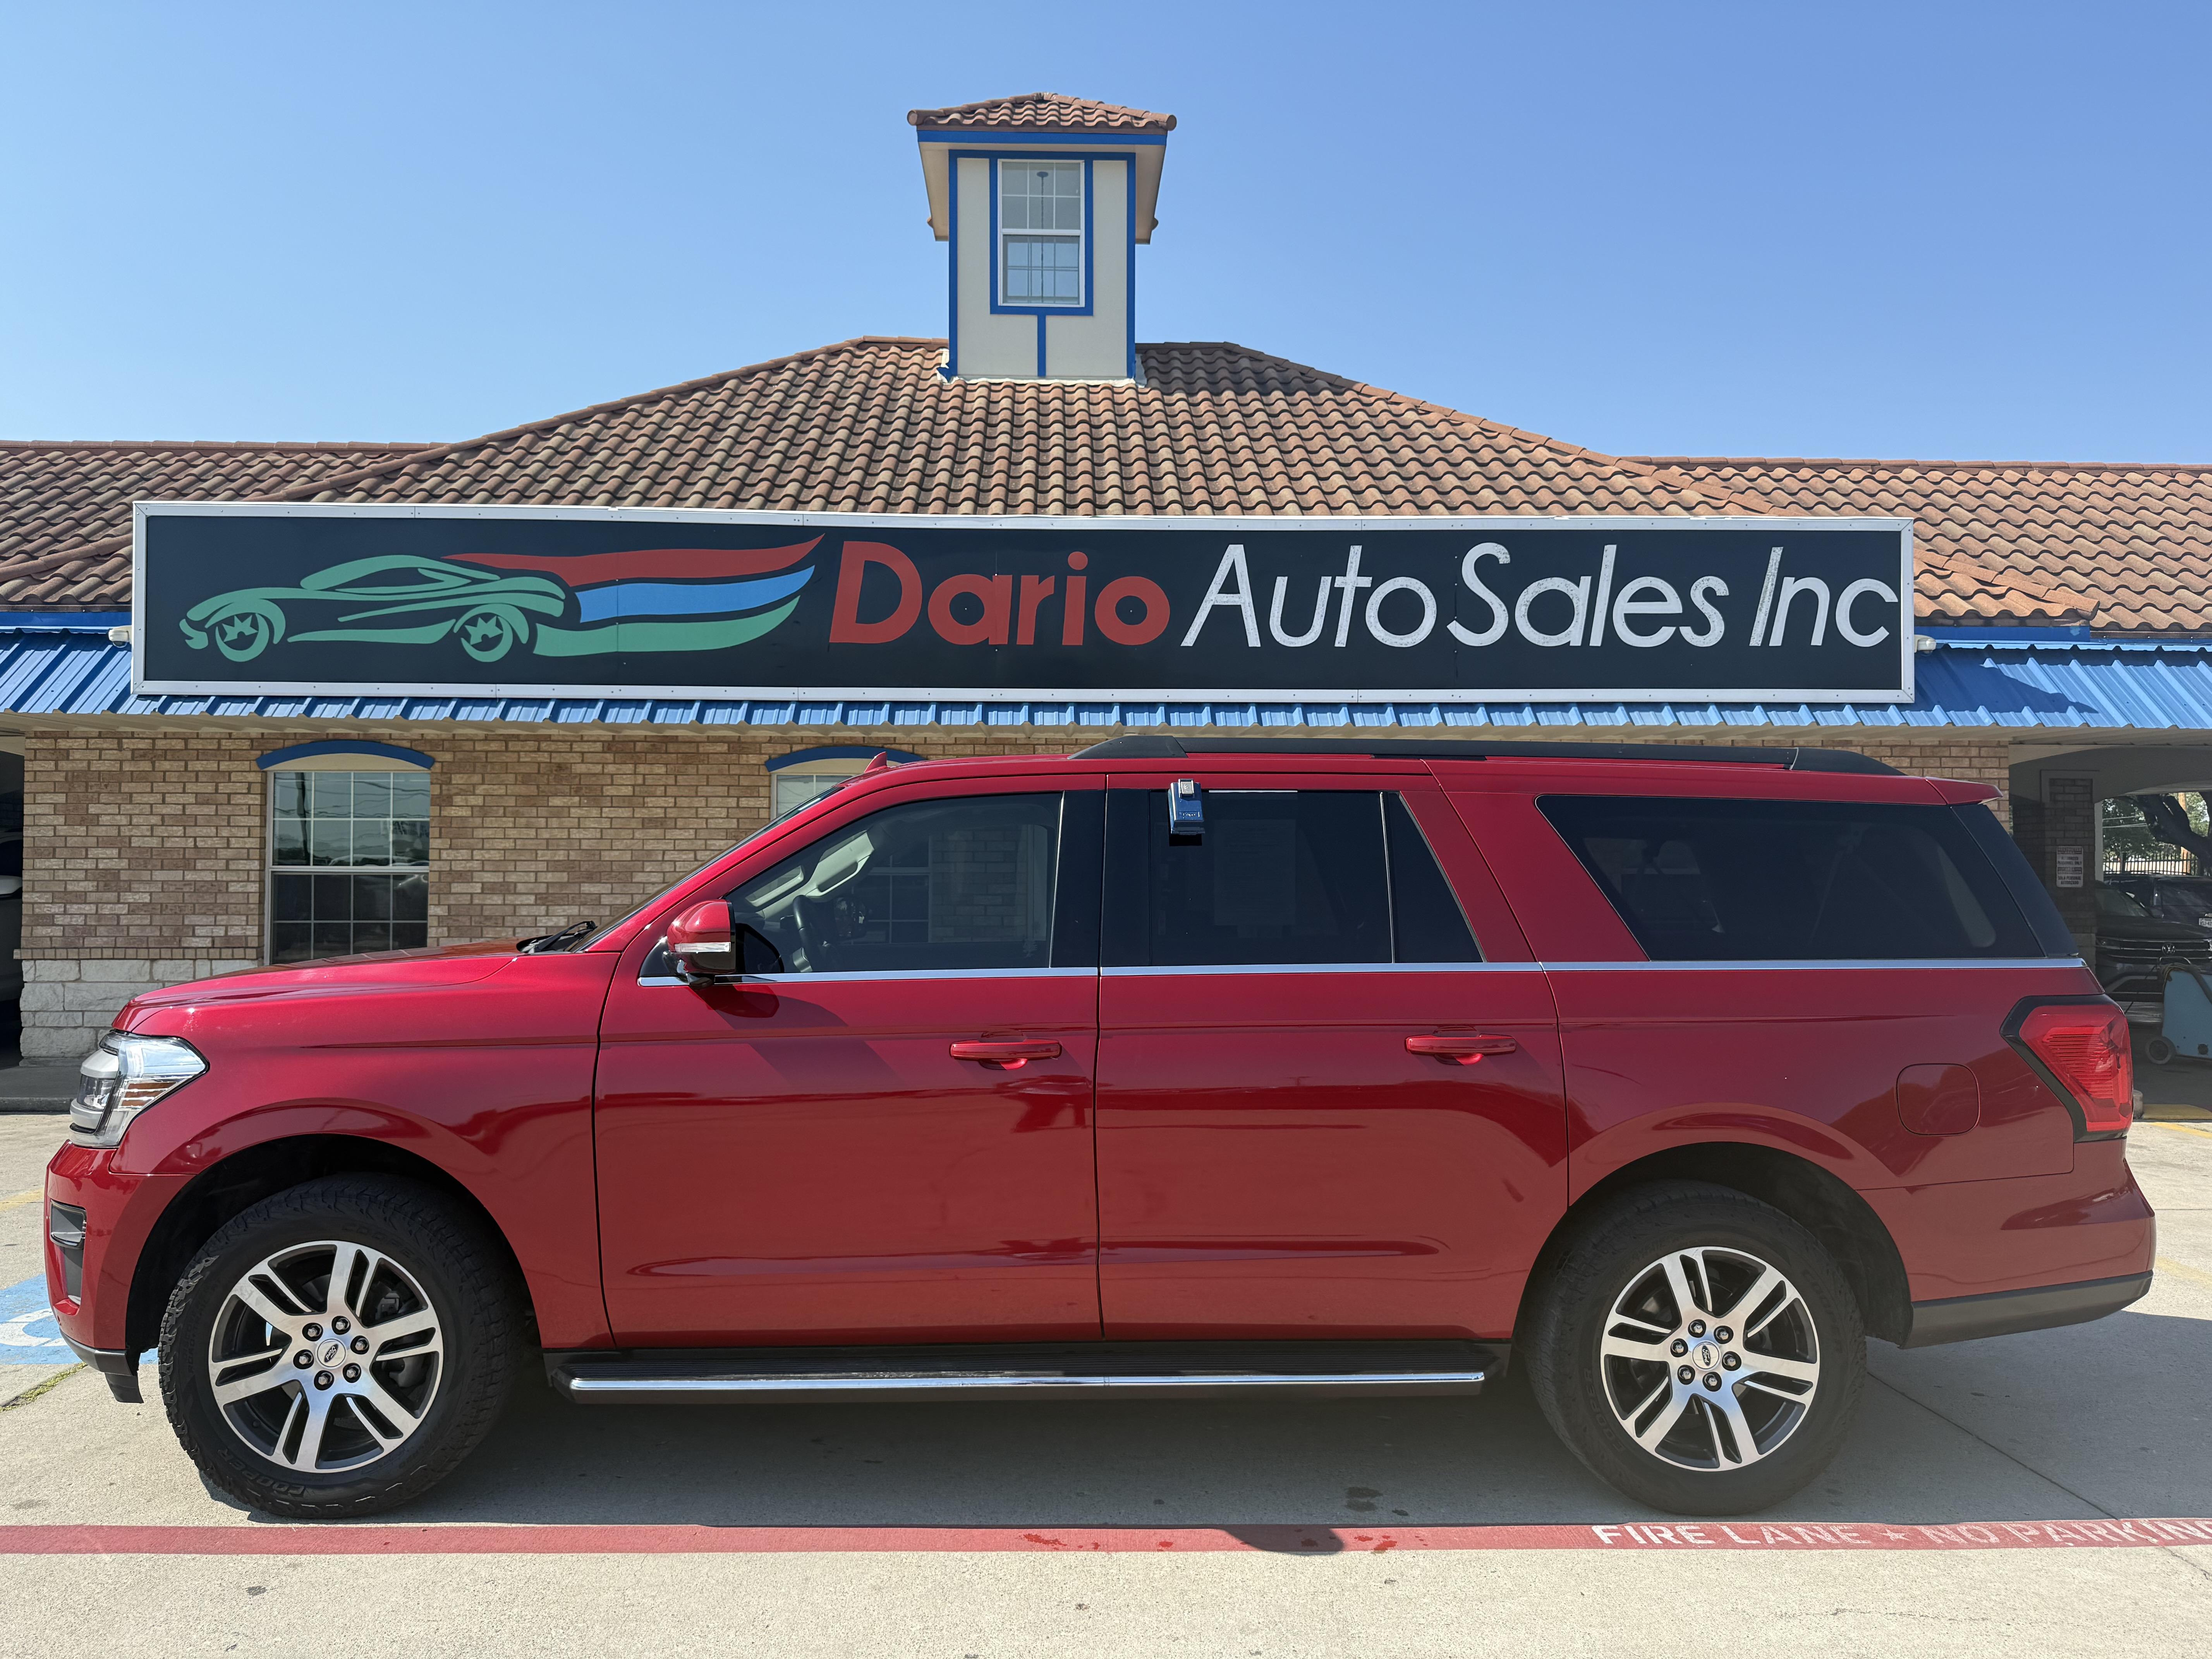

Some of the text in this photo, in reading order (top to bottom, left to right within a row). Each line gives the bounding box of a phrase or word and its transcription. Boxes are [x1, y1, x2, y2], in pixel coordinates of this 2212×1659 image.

[829, 541, 1898, 647] Dario Auto Sales Inc
[325, 1345, 337, 1361] Ford
[217, 1449, 305, 1495] COOPER
[1591, 1525, 1716, 1544] FIRE
[1721, 1525, 1872, 1544] LANE
[1916, 1525, 2000, 1544] NO
